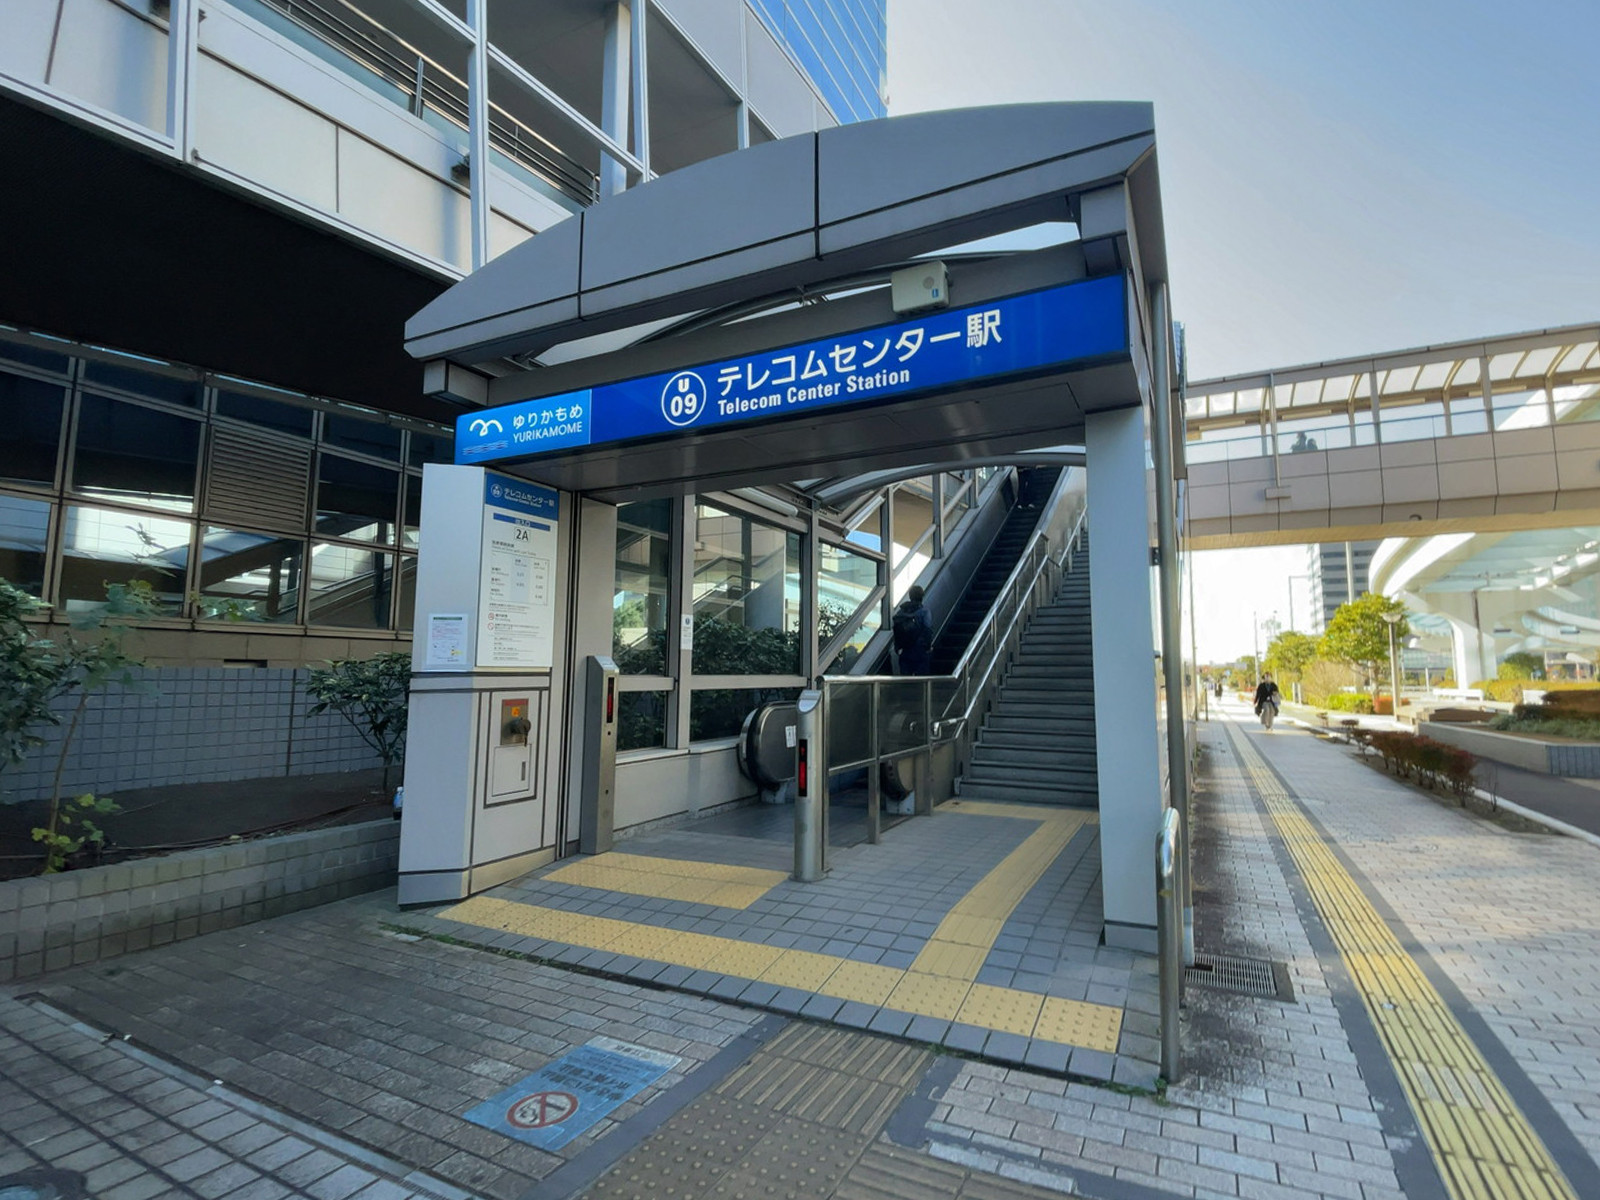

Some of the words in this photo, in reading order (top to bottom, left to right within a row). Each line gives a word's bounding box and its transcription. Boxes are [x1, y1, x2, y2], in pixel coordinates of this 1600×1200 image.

[718, 309, 1002, 396] テレコムセンター駅
[678, 378, 690, 393] U
[718, 394, 781, 416] Telecom
[787, 382, 841, 403] Center
[846, 369, 910, 393] Station
[513, 404, 583, 429] ゆりかもめ
[670, 393, 697, 417] 09
[513, 422, 583, 443] YURIKAMOME
[516, 529, 529, 541] 2A
